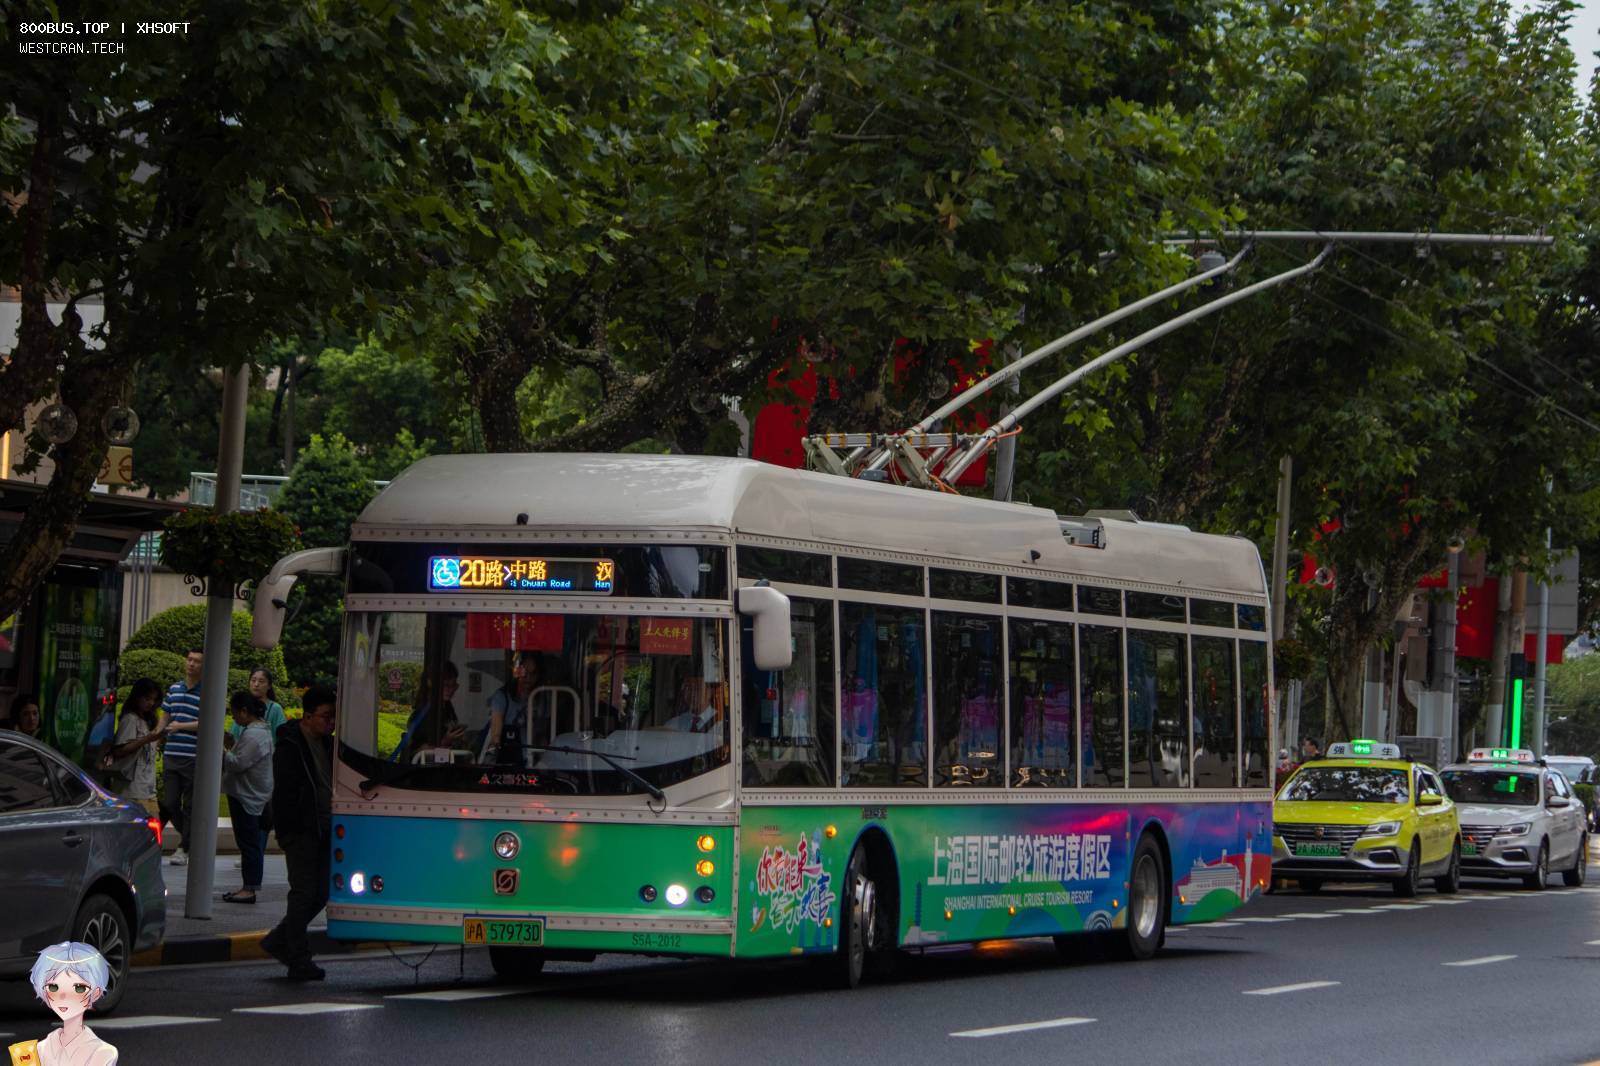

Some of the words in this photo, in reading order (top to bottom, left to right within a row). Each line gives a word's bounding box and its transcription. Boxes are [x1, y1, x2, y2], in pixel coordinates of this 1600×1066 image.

[521, 579, 547, 588] Chuan
[550, 580, 571, 588] Road
[927, 833, 1112, 886] 上海国际邮轮旅游度假区
[944, 896, 976, 911] SHANGHAI
[977, 893, 1023, 910] INTERNATIONAL
[1023, 893, 1045, 907] CRUISE
[1046, 891, 1070, 906] TOURISM
[1070, 890, 1093, 905] RESORT
[490, 922, 540, 942] 57973D
[631, 933, 682, 948] S5A-2012
